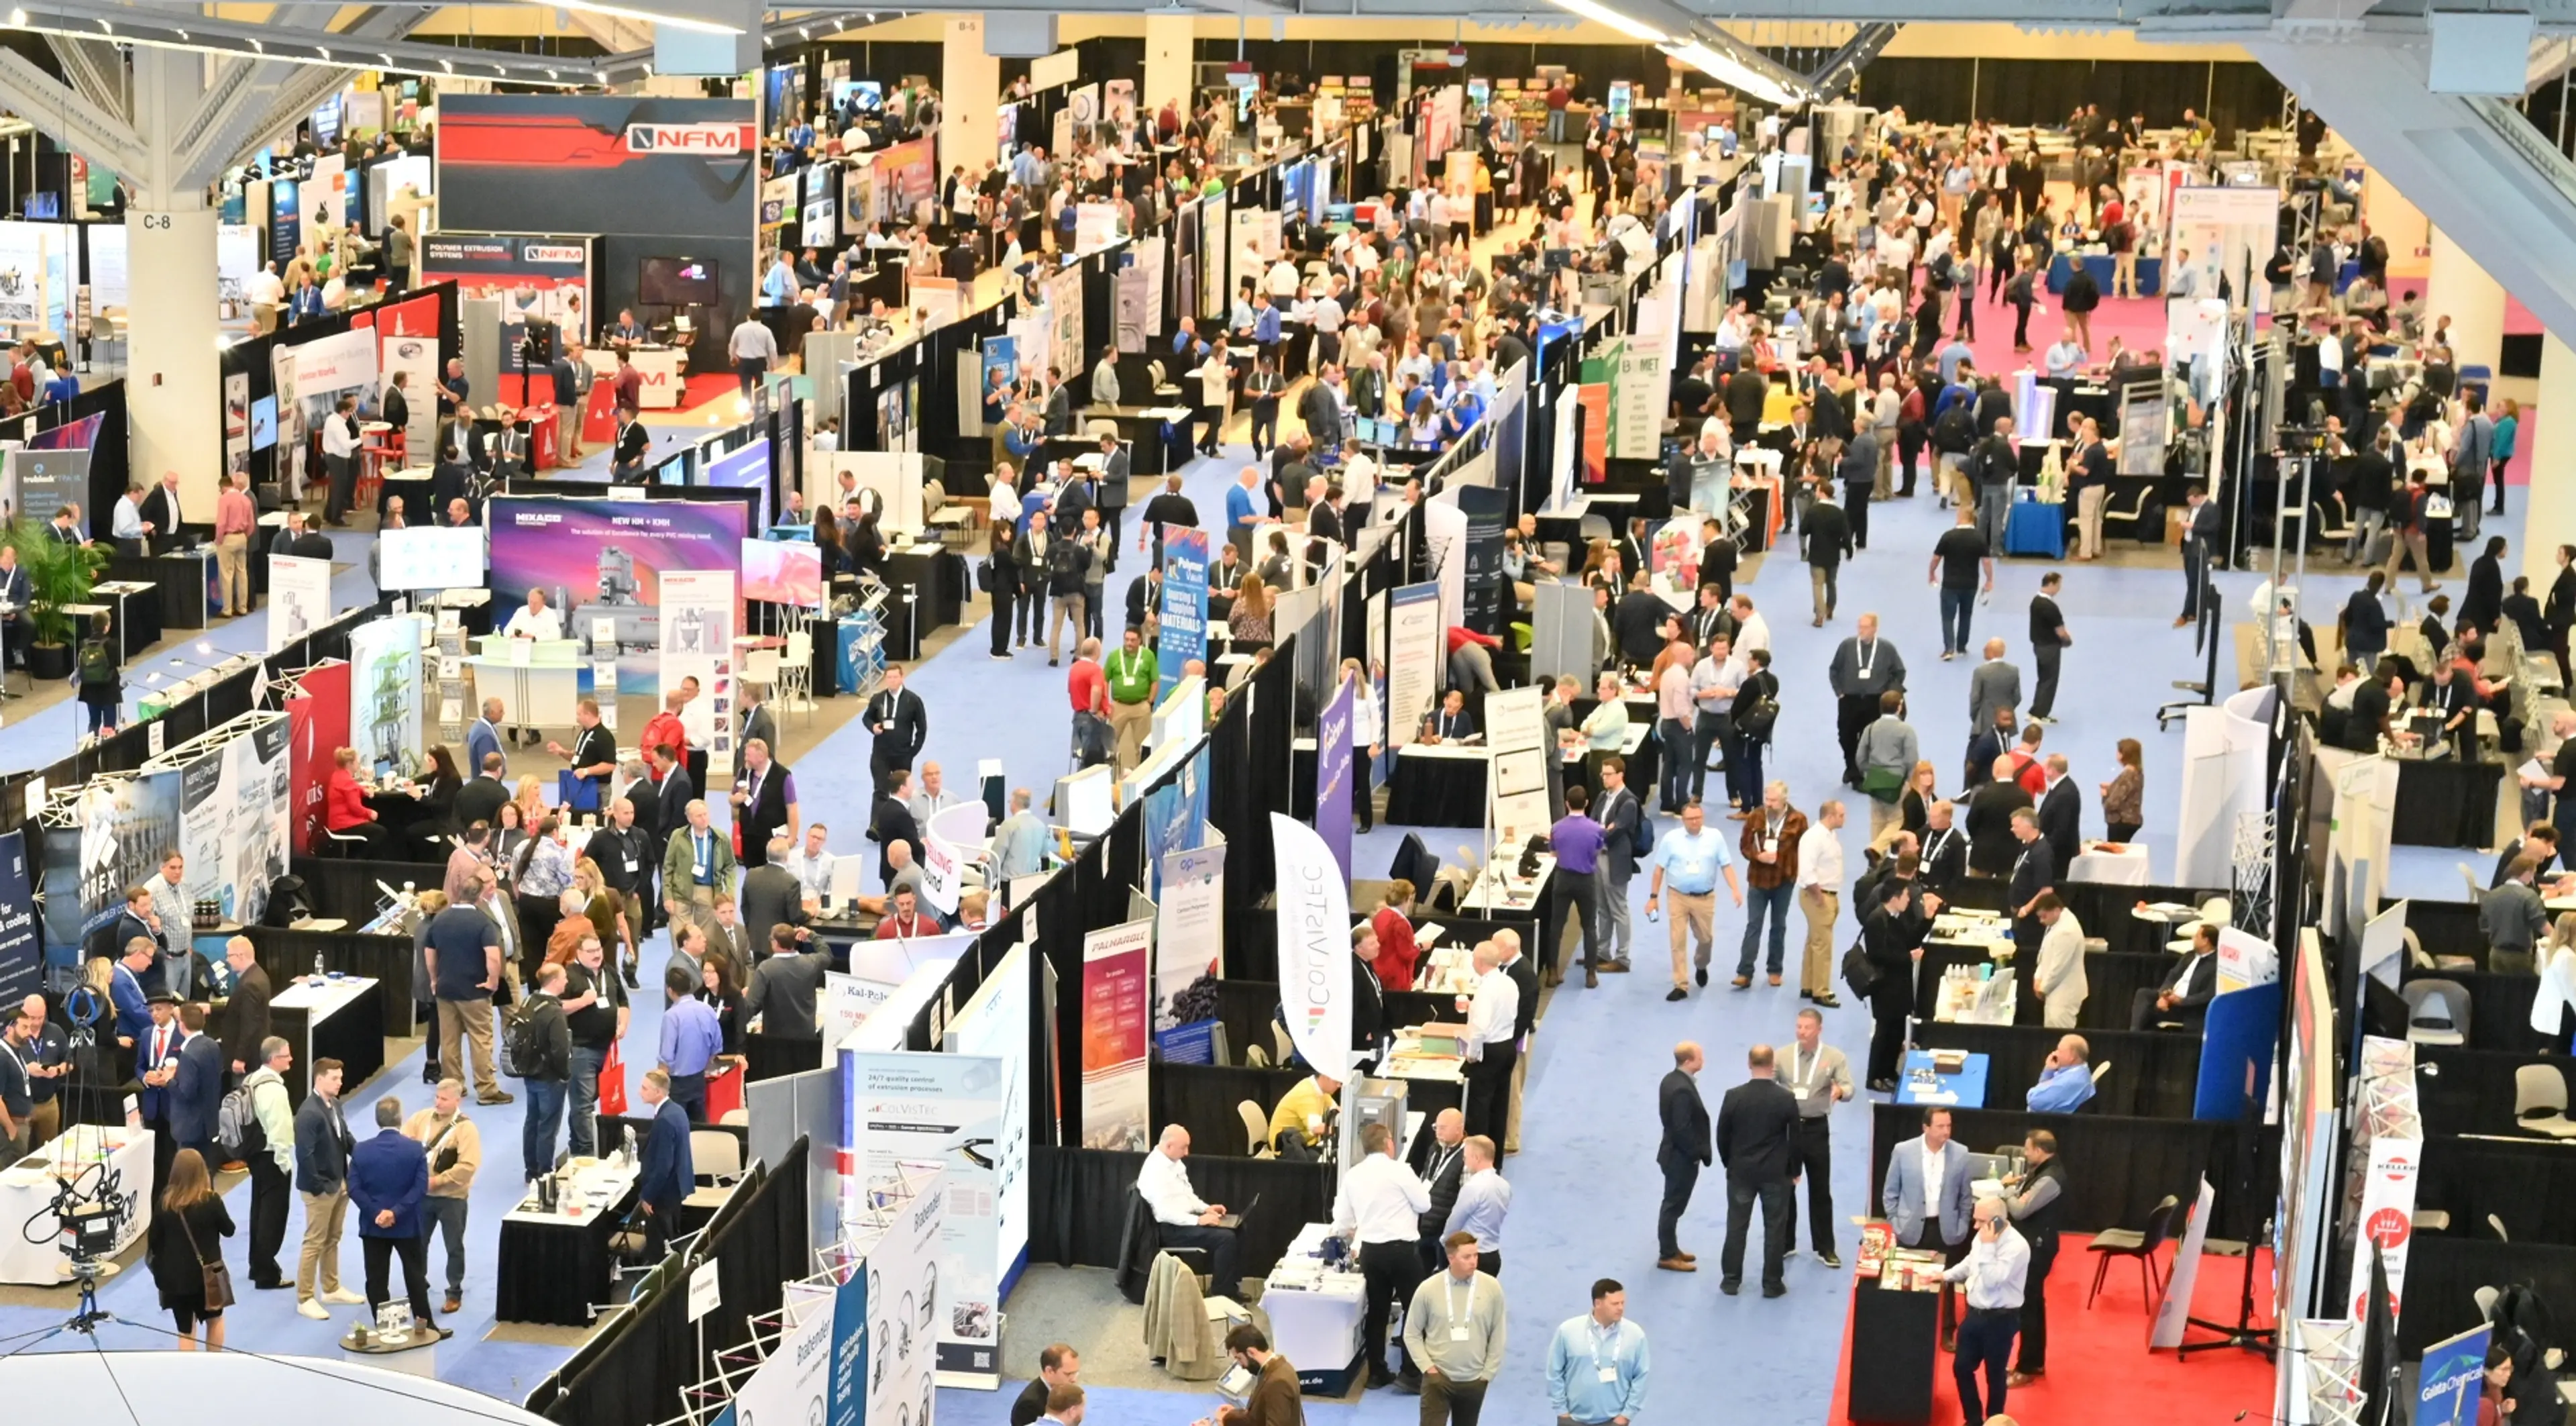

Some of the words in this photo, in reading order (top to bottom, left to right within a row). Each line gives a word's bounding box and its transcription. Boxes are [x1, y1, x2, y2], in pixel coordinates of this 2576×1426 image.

[657, 130, 736, 148] NFM
[144, 214, 170, 229] C-8
[429, 244, 462, 252] POLYMER
[464, 244, 504, 252] EXTRUSION
[540, 250, 582, 259] NFM
[516, 513, 561, 523] MIXACO
[612, 517, 631, 525] NEW
[1161, 613, 1201, 633] MATERIALS
[80, 870, 117, 909] RREX
[1, 903, 12, 915] for
[6, 913, 32, 929] cooling
[868, 1074, 884, 1082] 24/7
[885, 1075, 908, 1083] quality
[797, 1319, 830, 1367] Brabender
[2449, 1365, 2485, 1390] Chemical
